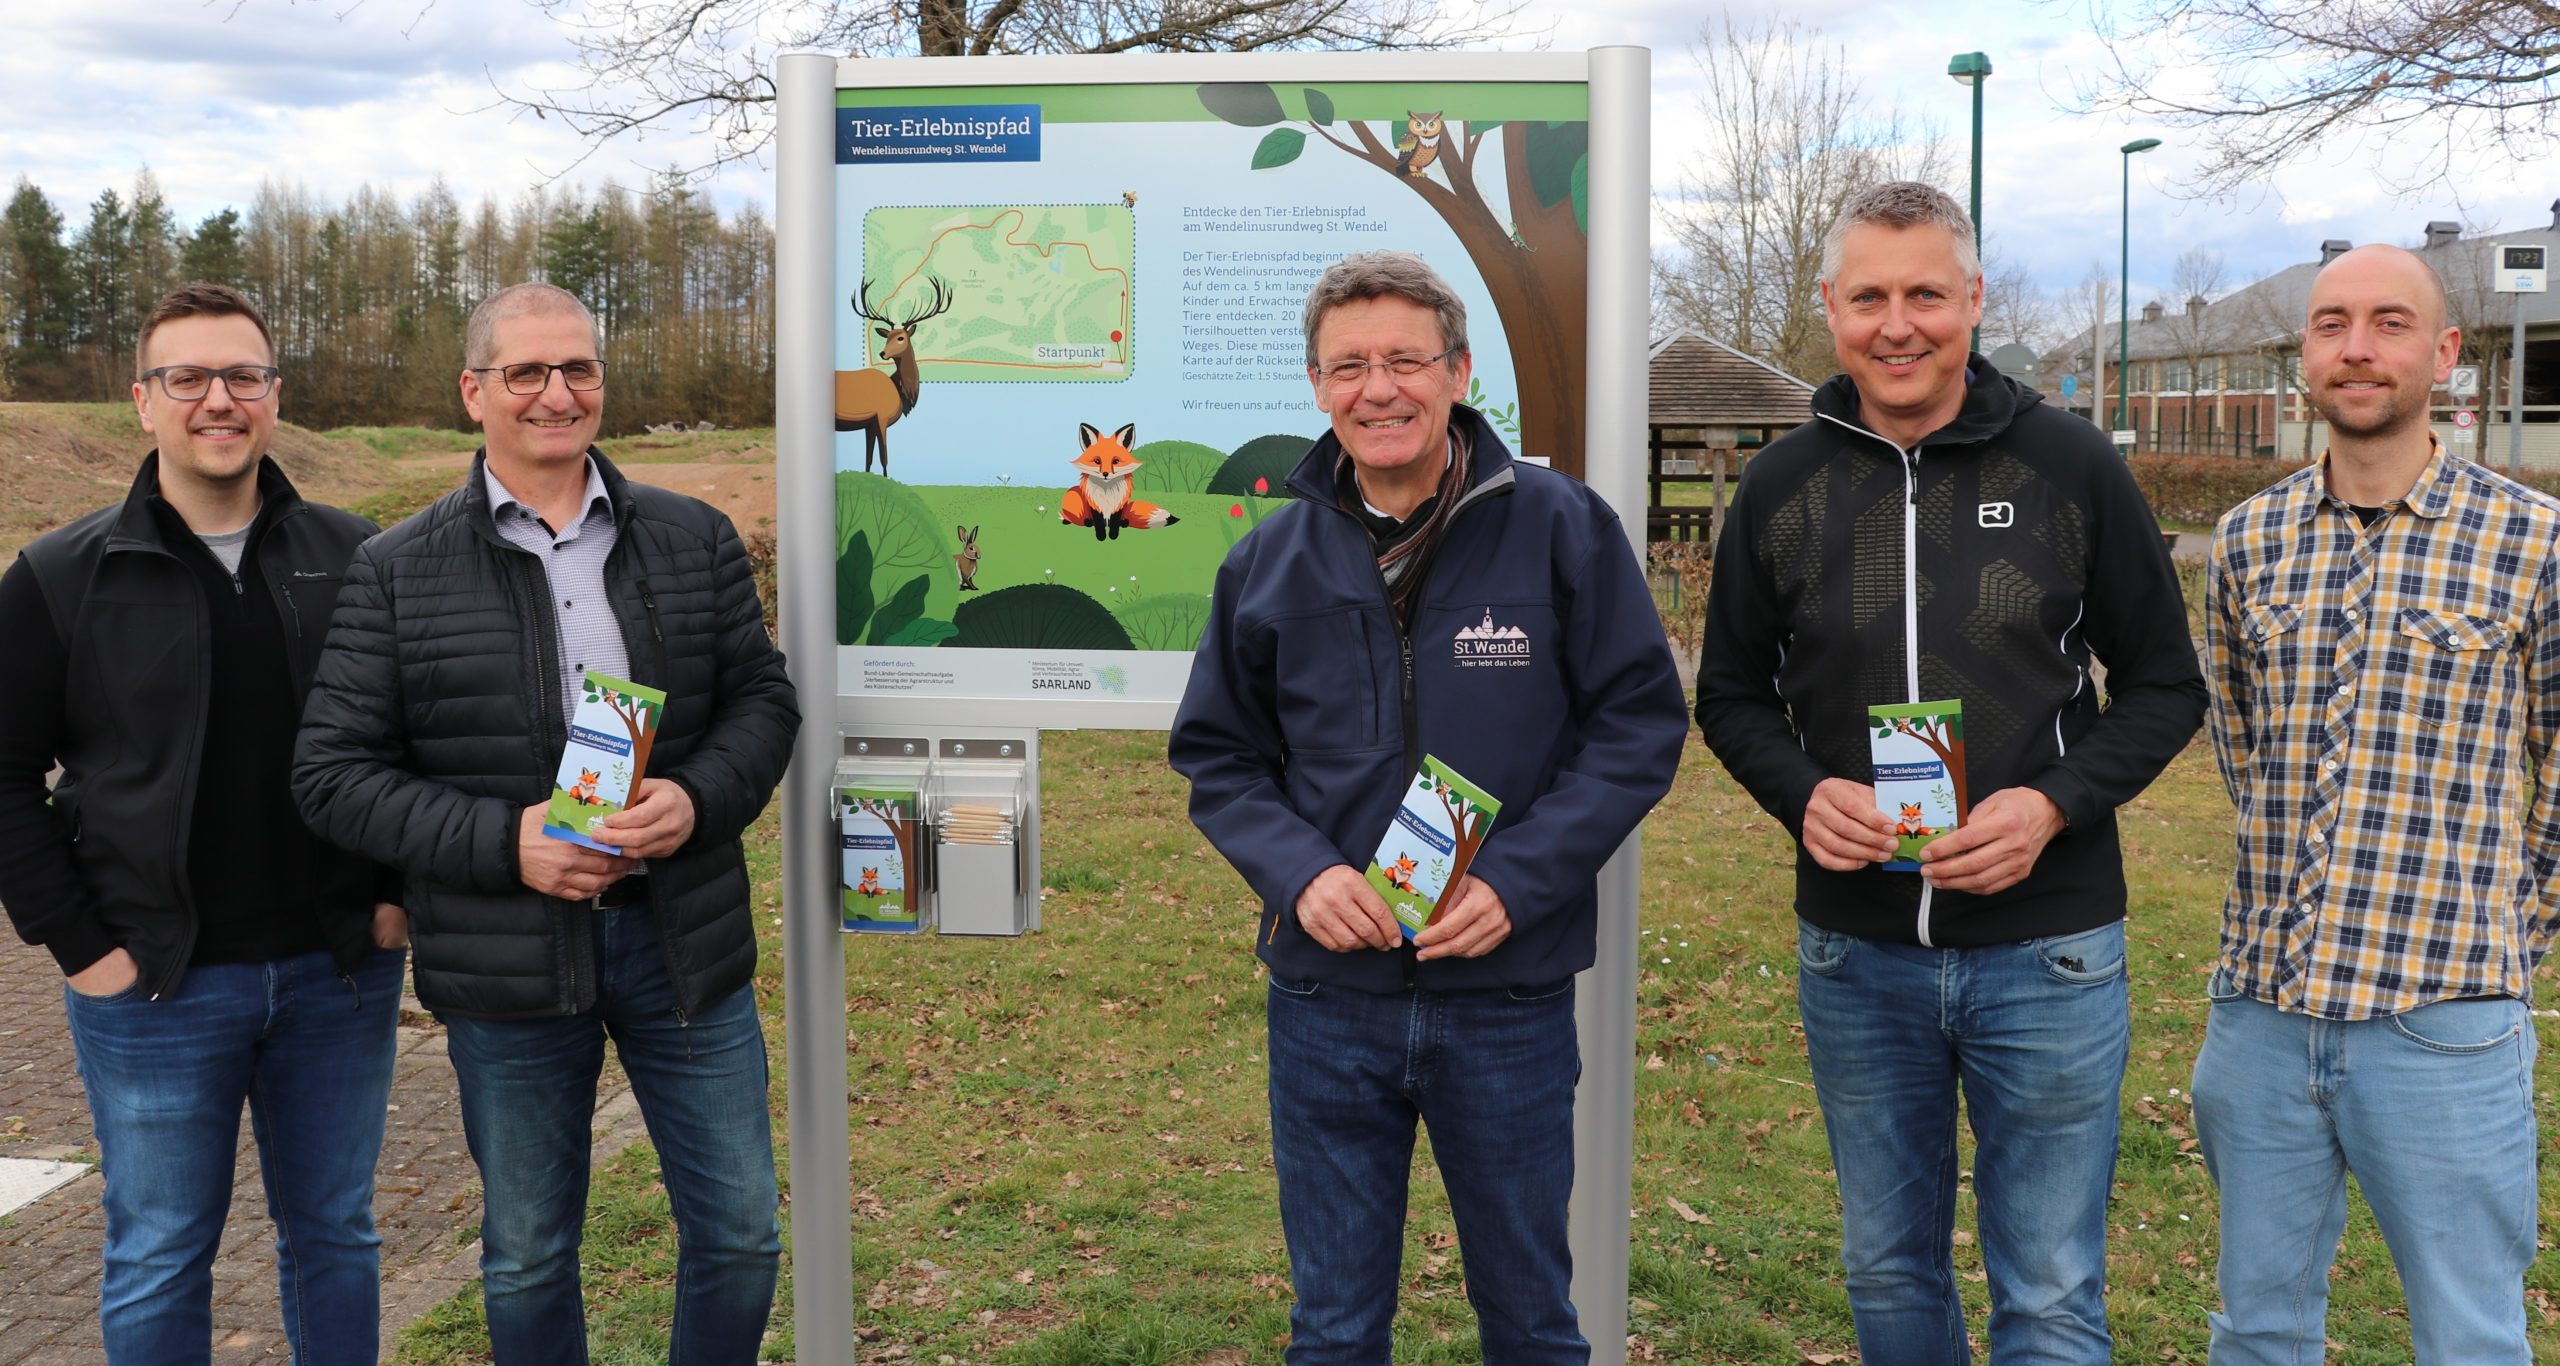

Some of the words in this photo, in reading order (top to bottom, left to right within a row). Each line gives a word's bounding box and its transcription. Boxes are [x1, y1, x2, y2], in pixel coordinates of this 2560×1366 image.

[852, 116, 1031, 140] Tier-Erlebnispfad
[852, 145, 952, 156] Wendelinusrundweg
[954, 145, 967, 154] St.
[969, 144, 1007, 154] Wendel
[1183, 206, 1238, 217] Entdecke
[1240, 206, 1261, 217] den
[1264, 206, 1367, 219] Tier-Erlebnispfad
[1183, 223, 1202, 232] am
[1204, 221, 1324, 234] Wendelinusrundweg
[1326, 221, 1341, 232] St.
[1344, 221, 1388, 232] Wendel
[1183, 251, 1203, 262] Der
[1205, 250, 1300, 263] Tier-Erlebnispfad
[1303, 251, 1344, 263] beginnt
[1183, 266, 1201, 277] des
[1204, 266, 1324, 279] Wendelinusrundwege
[1183, 281, 1202, 291] Auf
[1206, 281, 1231, 291] dem
[1234, 284, 1249, 292] ca.
[1253, 281, 1261, 292] 5
[1265, 281, 1282, 291] km
[1183, 295, 1220, 306] Kinder
[1224, 295, 1245, 306] und
[1182, 310, 1211, 321] Tiere
[1216, 310, 1276, 321] entdecken.
[1282, 310, 1296, 321] 20
[1182, 325, 1267, 336] Tiersilhouetten
[1182, 340, 1222, 353] Weges.
[1227, 340, 1258, 351] Diese
[1262, 340, 1304, 351] müssen
[1038, 346, 1105, 360] Startpunkt
[1183, 355, 1214, 366] Karte
[1216, 355, 1233, 366] auf
[1235, 355, 1255, 366] der
[1182, 371, 1234, 382] (Geschätzte
[1236, 371, 1256, 381] Zeit:
[1182, 400, 1203, 411] Wir
[1205, 400, 1241, 411] freuen
[1243, 403, 1262, 411] uns
[1264, 400, 1282, 411] auf
[1284, 400, 1314, 411] euch!
[2459, 414, 2470, 423] 10
[1032, 679, 1091, 690] SAARLAND
[574, 730, 627, 749] Tier-Erlebnispfad
[1877, 765, 1940, 775] Tier-Erlebnispfad
[1401, 810, 1450, 848] Tier-Erlebnispfad
